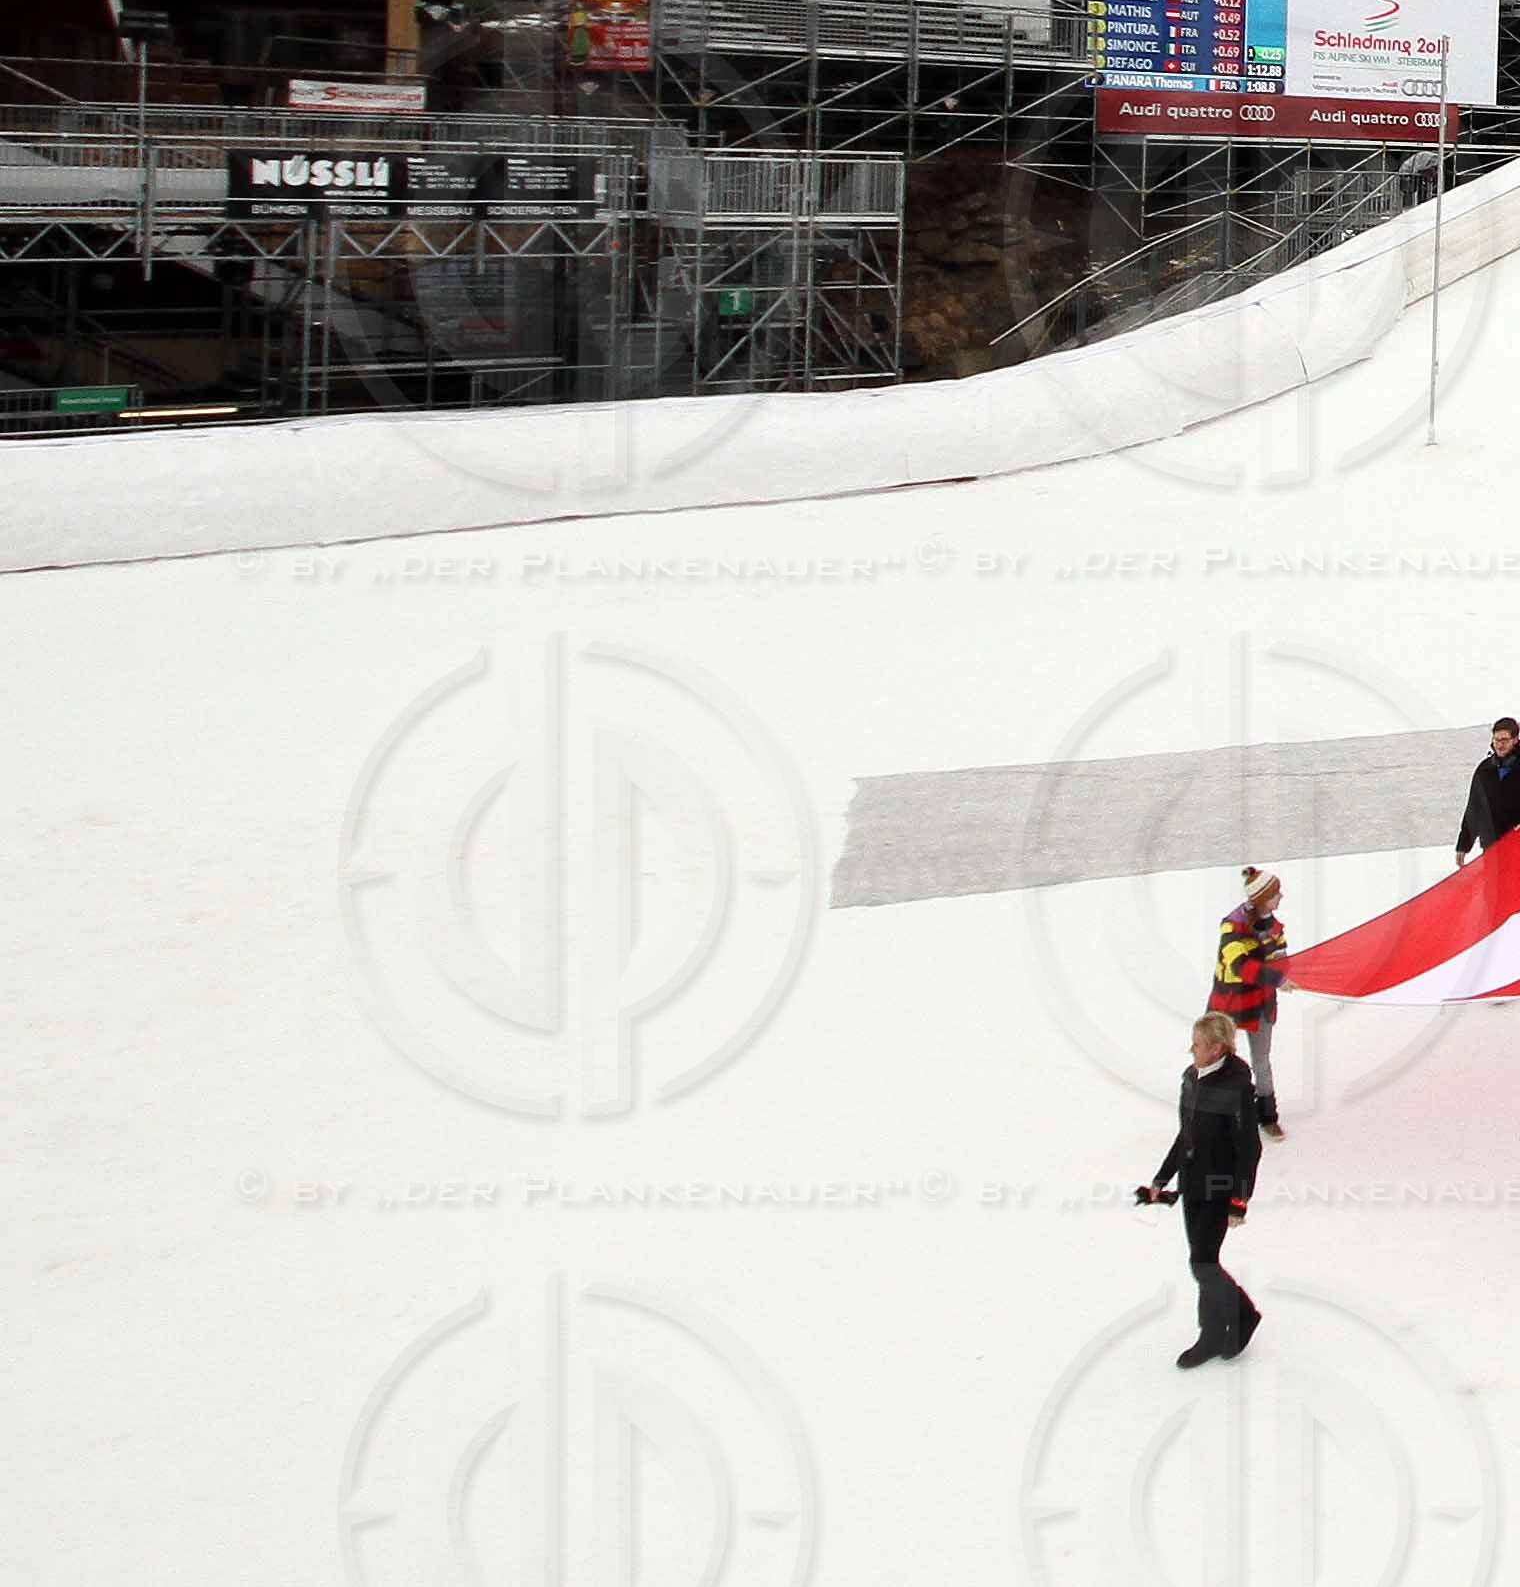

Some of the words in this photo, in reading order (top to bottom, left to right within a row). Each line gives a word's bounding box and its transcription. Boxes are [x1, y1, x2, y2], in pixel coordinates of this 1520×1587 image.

[1108, 4, 1152, 18] MATHIS
[1180, 11, 1199, 21] AUT
[1213, 13, 1240, 25] +0.49
[1180, 28, 1198, 37] FRA
[1213, 30, 1240, 41] +0.52
[1314, 30, 1412, 56] Schladming
[1180, 45, 1197, 55] ITA
[1212, 47, 1240, 58] +0.69
[1106, 57, 1152, 71] DEFAGO
[1180, 62, 1196, 71] SUI
[1212, 63, 1239, 75] +0.82
[1106, 73, 1153, 87] FANARA
[1154, 75, 1193, 89] Thomas
[1220, 81, 1238, 91] FRA
[1119, 101, 1161, 116] Audi
[1167, 105, 1232, 119] quattro
[1309, 109, 1346, 123] Audi
[1351, 113, 1409, 125] quattro
[251, 204, 308, 215] BÜHNEN
[328, 205, 388, 215] TRIBÜNEN
[406, 206, 473, 216] MESSEBAU
[487, 205, 577, 216] SONDERBAUTEN
[728, 290, 740, 311] 1
